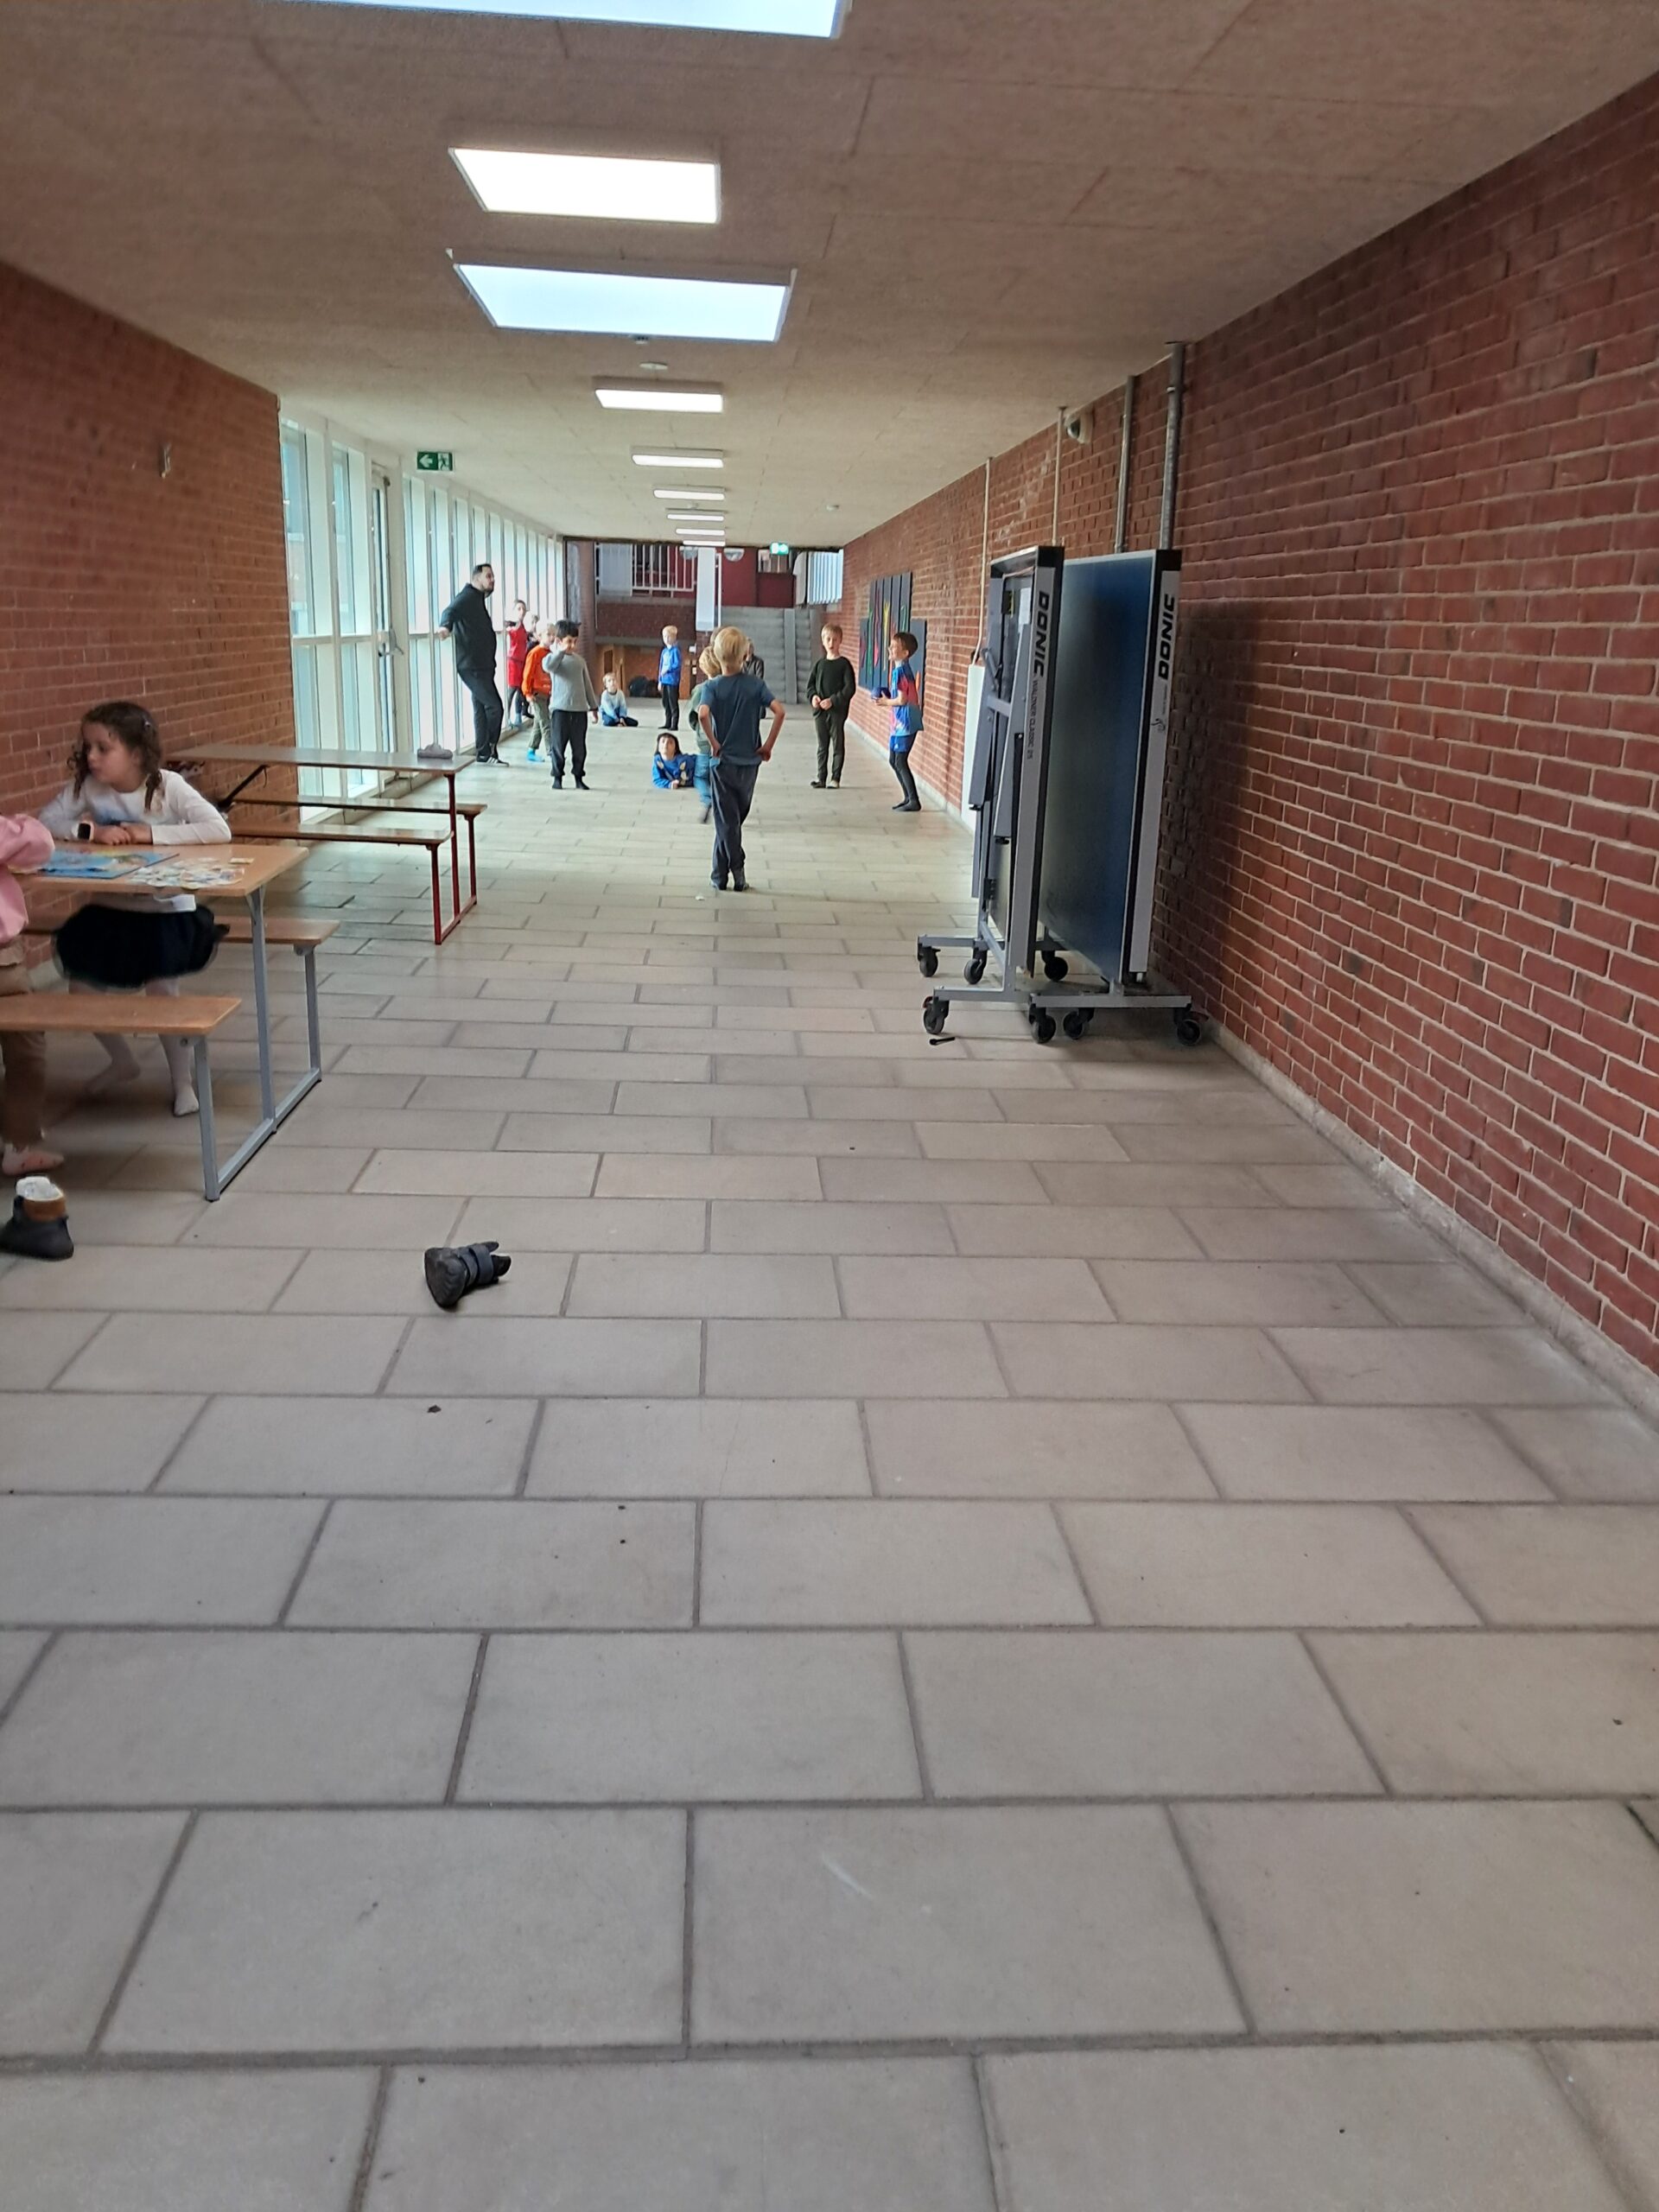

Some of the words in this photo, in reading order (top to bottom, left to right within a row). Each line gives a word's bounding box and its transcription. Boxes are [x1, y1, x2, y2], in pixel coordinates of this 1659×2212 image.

[1034, 590, 1050, 677] DONIC
[1158, 594, 1175, 680] DONIC
[1030, 680, 1039, 717] WALDNER
[1027, 718, 1036, 747] CLASSIC
